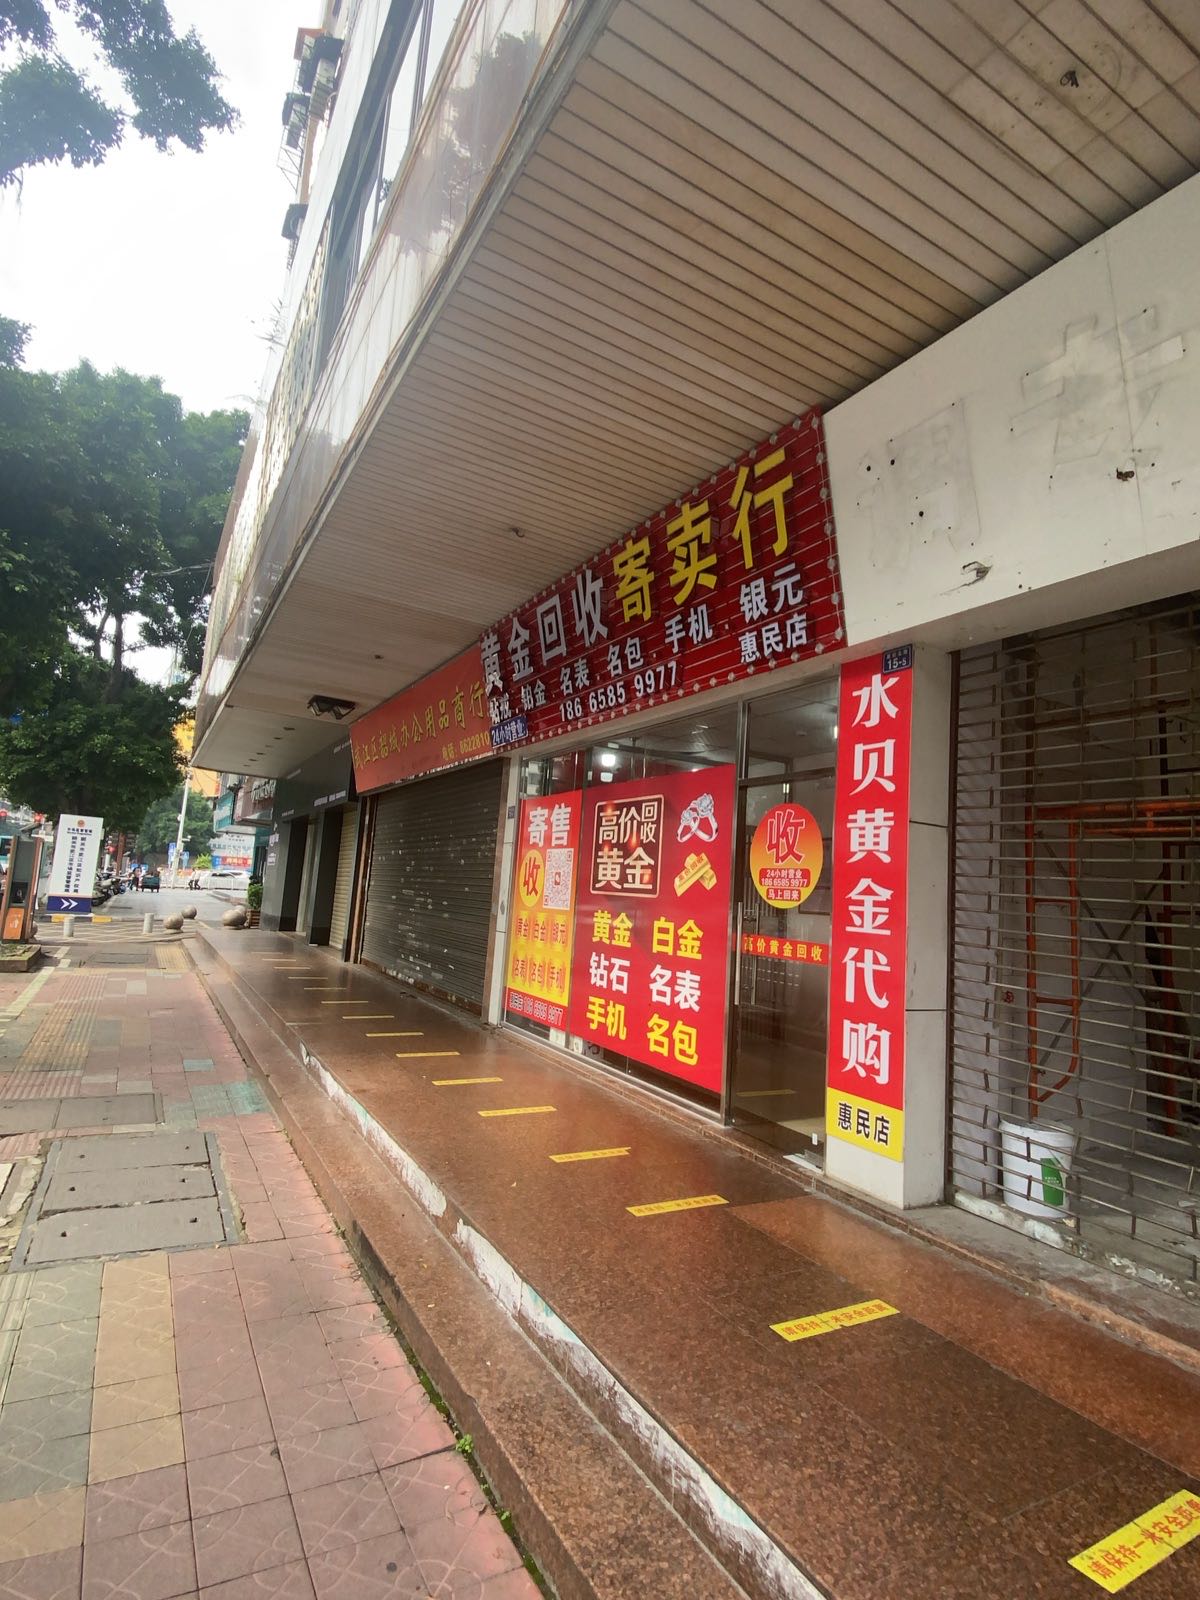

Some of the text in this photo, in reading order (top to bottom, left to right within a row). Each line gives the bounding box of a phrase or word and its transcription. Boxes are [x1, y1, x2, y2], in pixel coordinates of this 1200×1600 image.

[560, 658, 590, 696] 名表
[607, 637, 644, 677] 名包
[664, 603, 713, 653] 手机
[739, 562, 803, 624] 银元
[739, 612, 807, 664] 惠民店
[559, 660, 677, 722] 186 6585 9977
[528, 802, 571, 847] 寄售
[766, 809, 805, 864] 收
[523, 856, 541, 897] 收
[596, 847, 655, 890] 黄金
[761, 877, 808, 888] 186 6585 9977
[766, 868, 803, 879] 24小时营业
[841, 673, 900, 1085] 水贝黄金代购
[592, 909, 633, 948] 黄金
[652, 916, 704, 960] 白金
[744, 936, 823, 962] 高价黄金回收
[589, 951, 631, 995] 钻石
[649, 964, 701, 1013] 名表
[586, 996, 627, 1042] 手机
[646, 1013, 698, 1066] 名包
[837, 1102, 891, 1145] 惠民店
